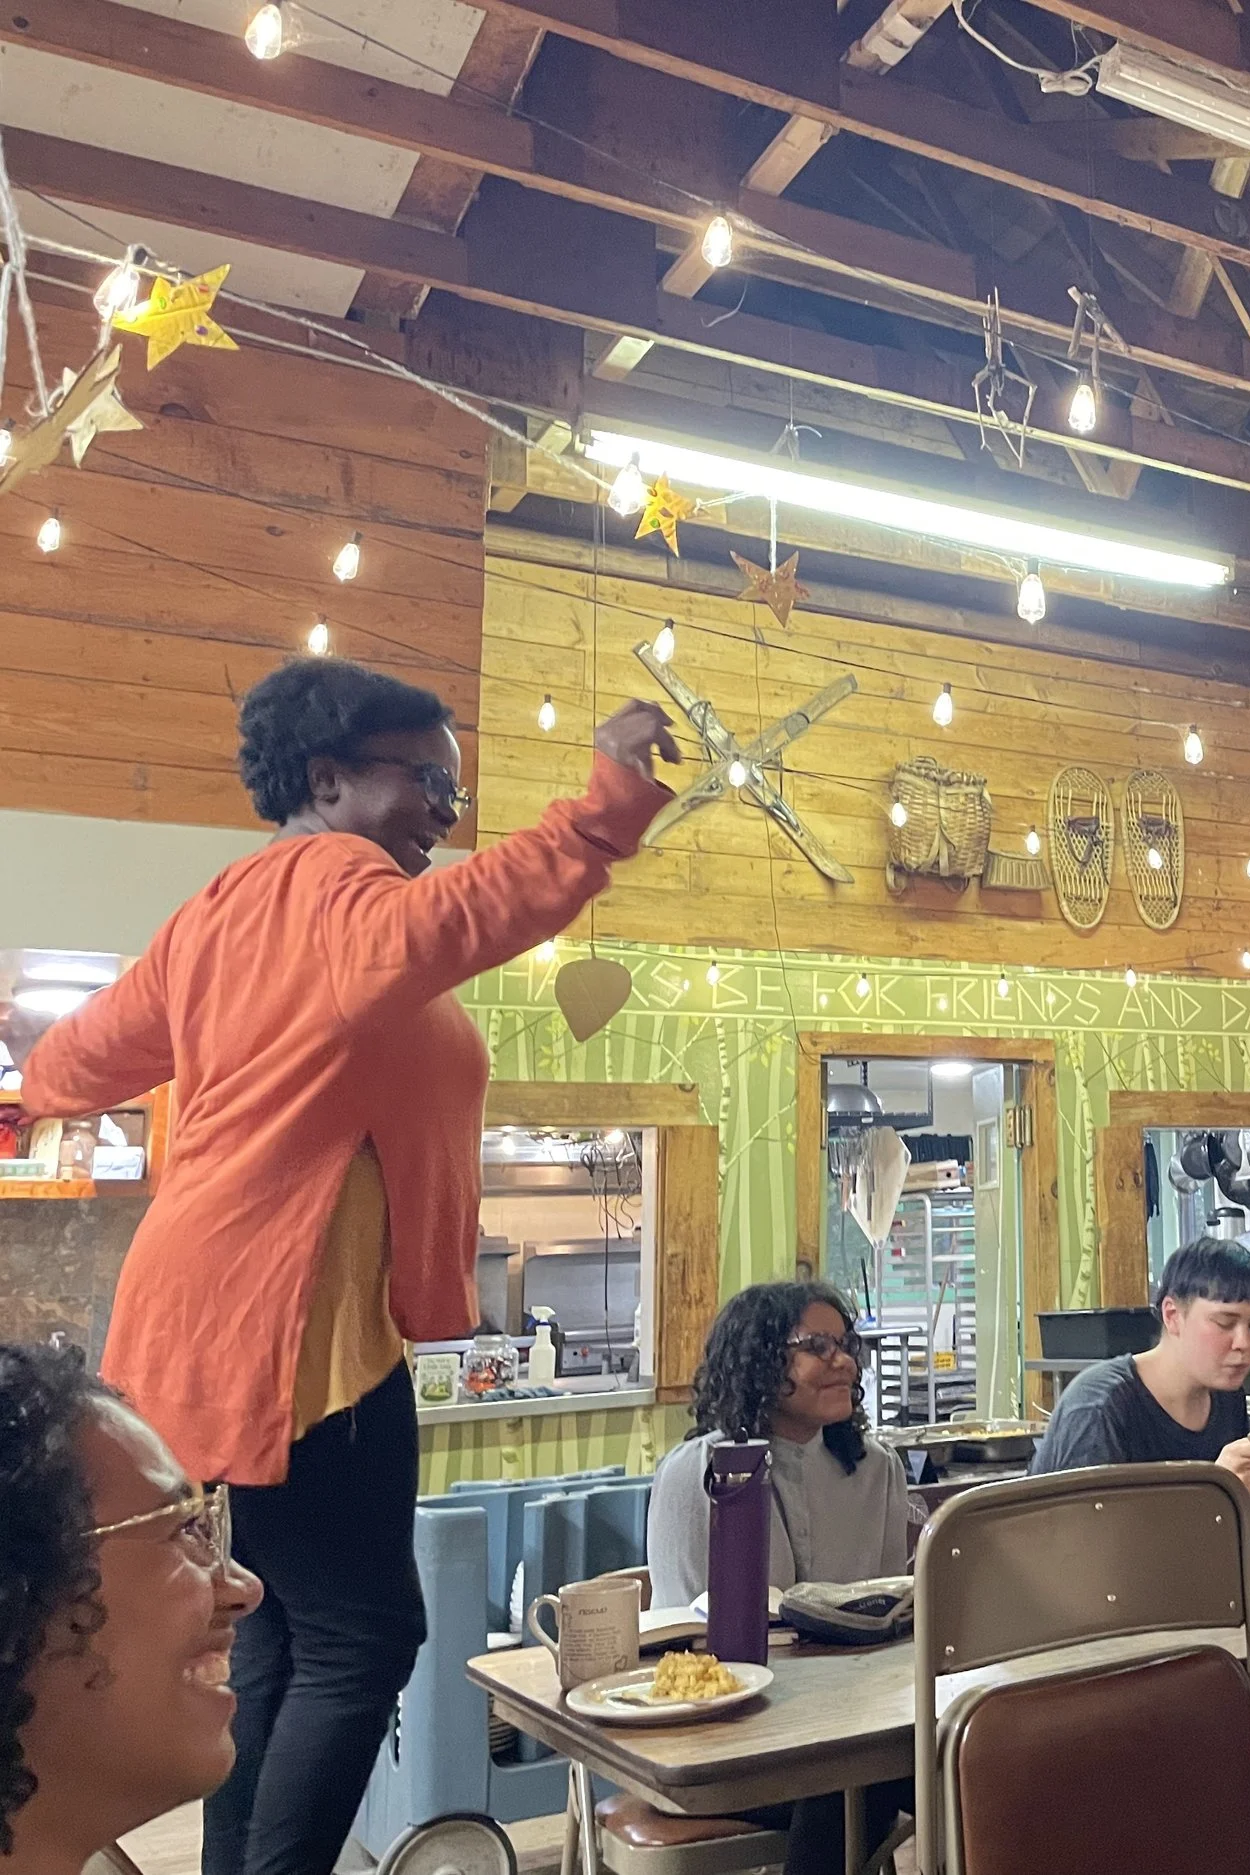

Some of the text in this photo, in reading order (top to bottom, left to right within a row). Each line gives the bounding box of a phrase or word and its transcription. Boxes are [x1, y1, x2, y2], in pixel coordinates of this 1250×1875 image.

[711, 965, 784, 1011] BE
[812, 970, 905, 1016] FOR
[926, 975, 1101, 1025] FRIENDS
[1118, 986, 1202, 1029] AND
